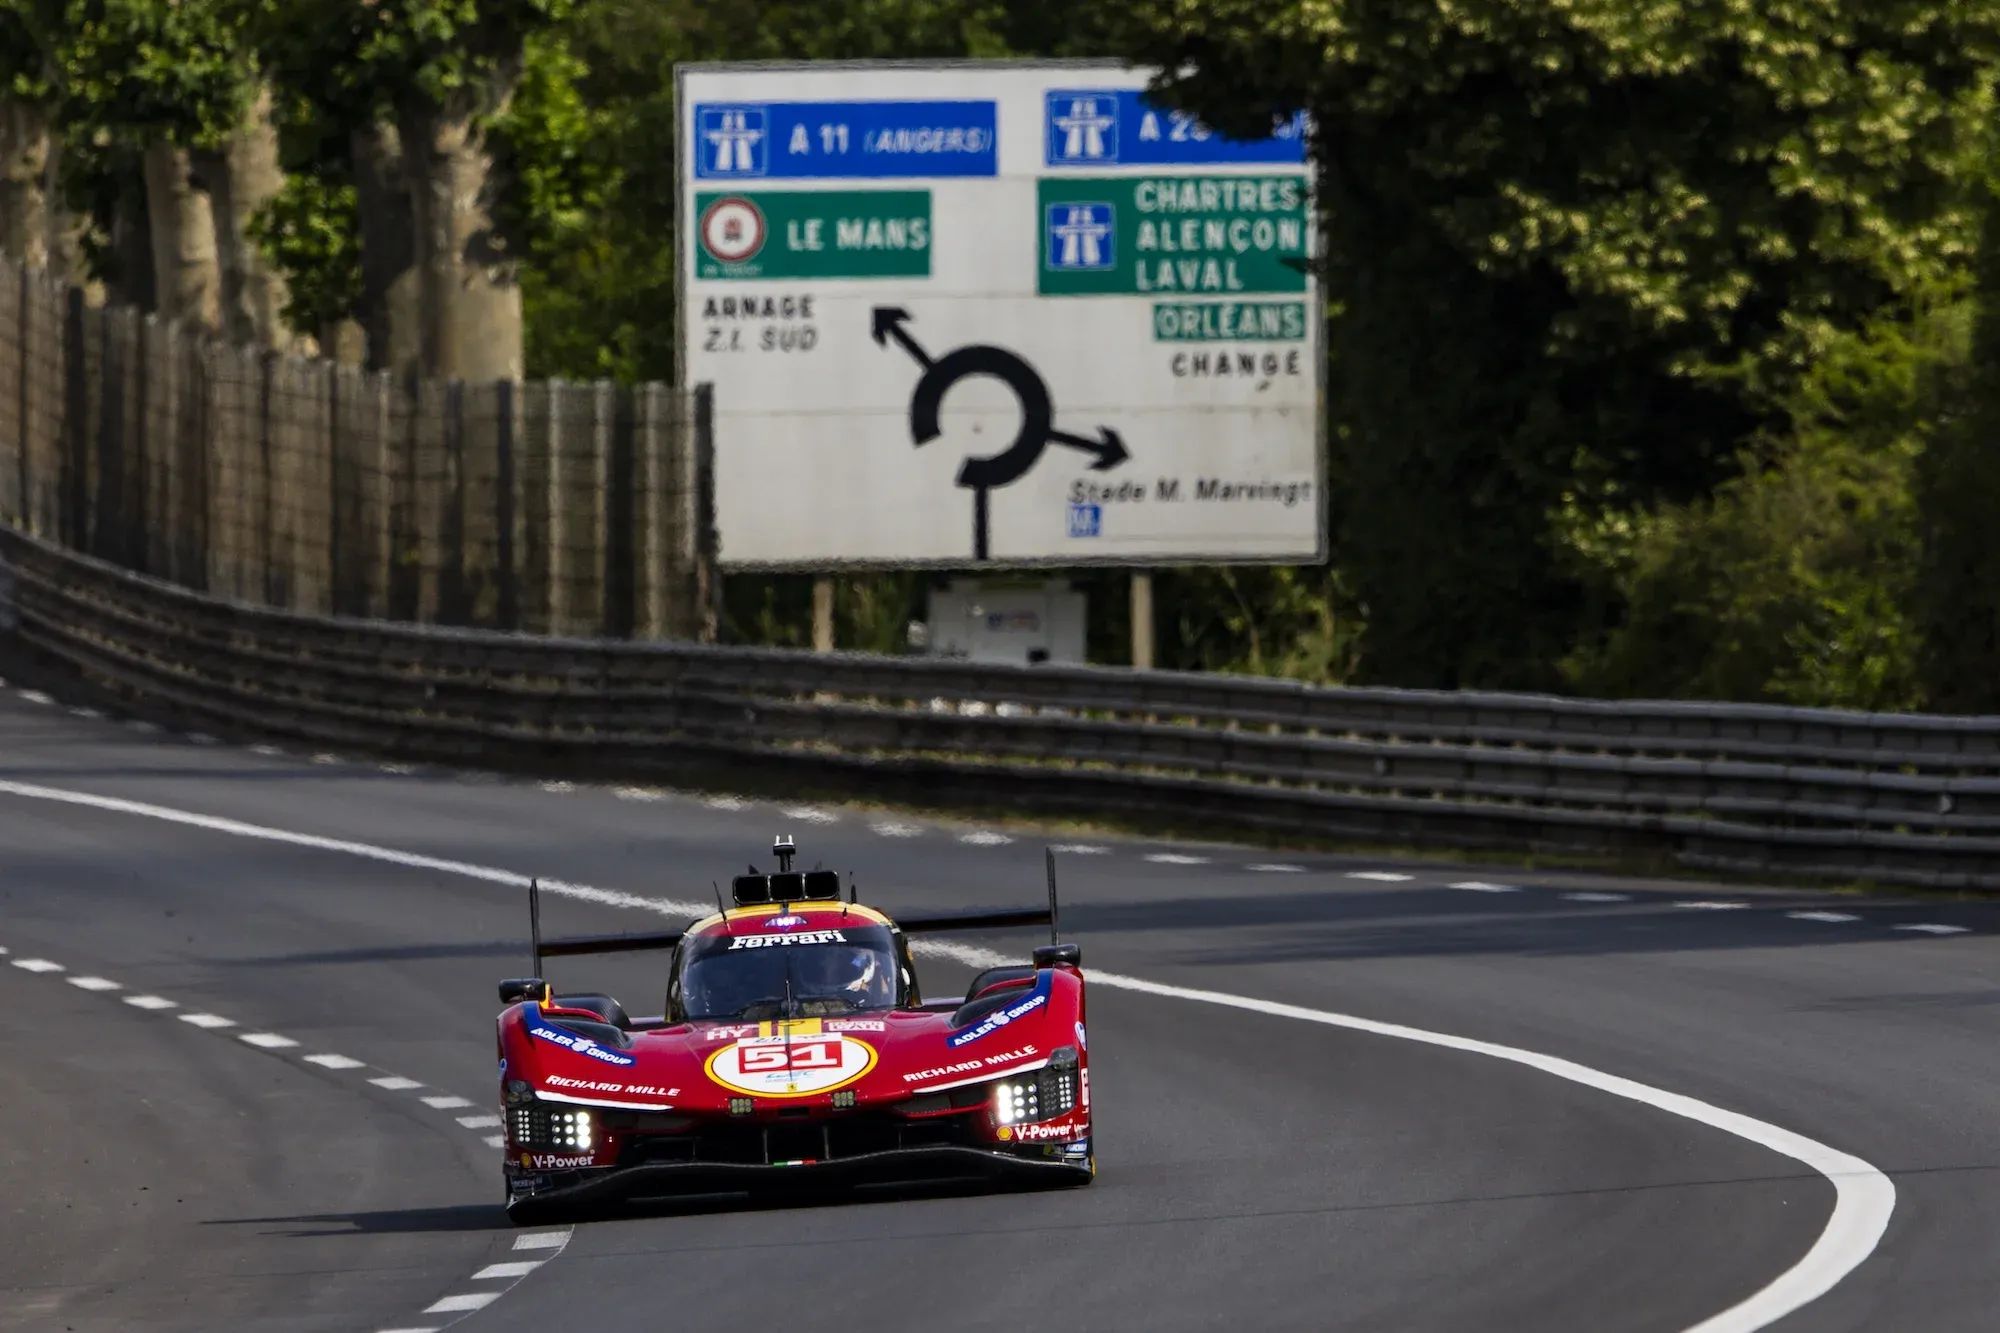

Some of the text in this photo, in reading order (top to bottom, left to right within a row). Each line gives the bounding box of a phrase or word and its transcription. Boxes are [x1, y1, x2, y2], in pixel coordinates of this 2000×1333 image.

[789, 123, 809, 154] A
[819, 123, 849, 154] 11
[1139, 111, 1161, 142] A
[1134, 180, 1300, 213] CHARTRES
[787, 217, 930, 251] LE MANS
[1136, 218, 1300, 254] ALENÇON
[1135, 259, 1244, 291] LAVAL
[703, 295, 815, 319] ARNAGE
[1156, 304, 1301, 338] ORLÉANS
[760, 325, 817, 351] SUD
[1069, 479, 1146, 503] Stade
[728, 929, 847, 950] Ferrari
[954, 995, 1046, 1047] ADLER GROUP
[530, 1026, 632, 1066] ADLER GROUP
[744, 1043, 838, 1070] 51
[902, 1044, 1038, 1083] RICHARD MILLE
[545, 1074, 681, 1097] RICHARD MILLE
[1015, 1123, 1071, 1140] V-Power
[532, 1153, 595, 1169] V-Power
